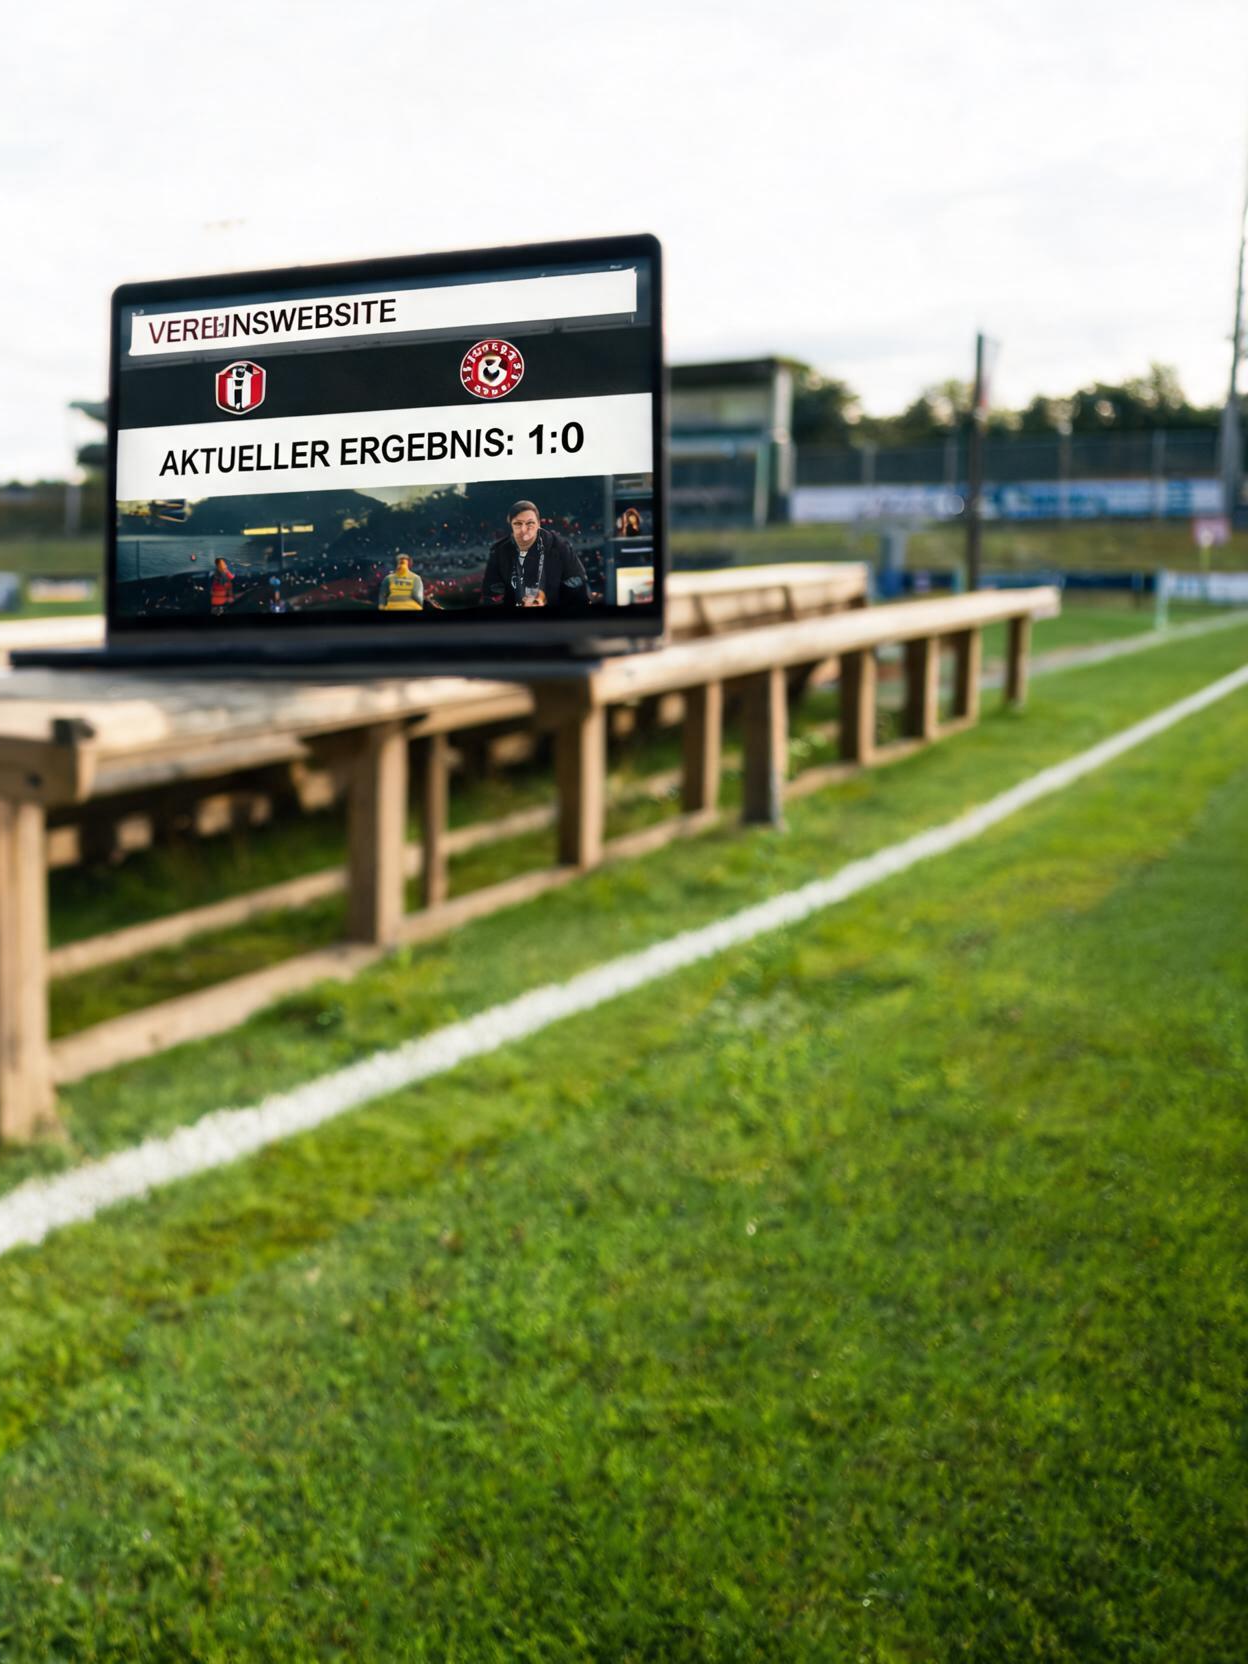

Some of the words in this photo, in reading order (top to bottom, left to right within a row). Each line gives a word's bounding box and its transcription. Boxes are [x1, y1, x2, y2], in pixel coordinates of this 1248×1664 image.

[159, 439, 331, 477] AKTUELLER
[340, 427, 514, 466] ERGEBNIS:
[528, 421, 585, 455] 1:0
